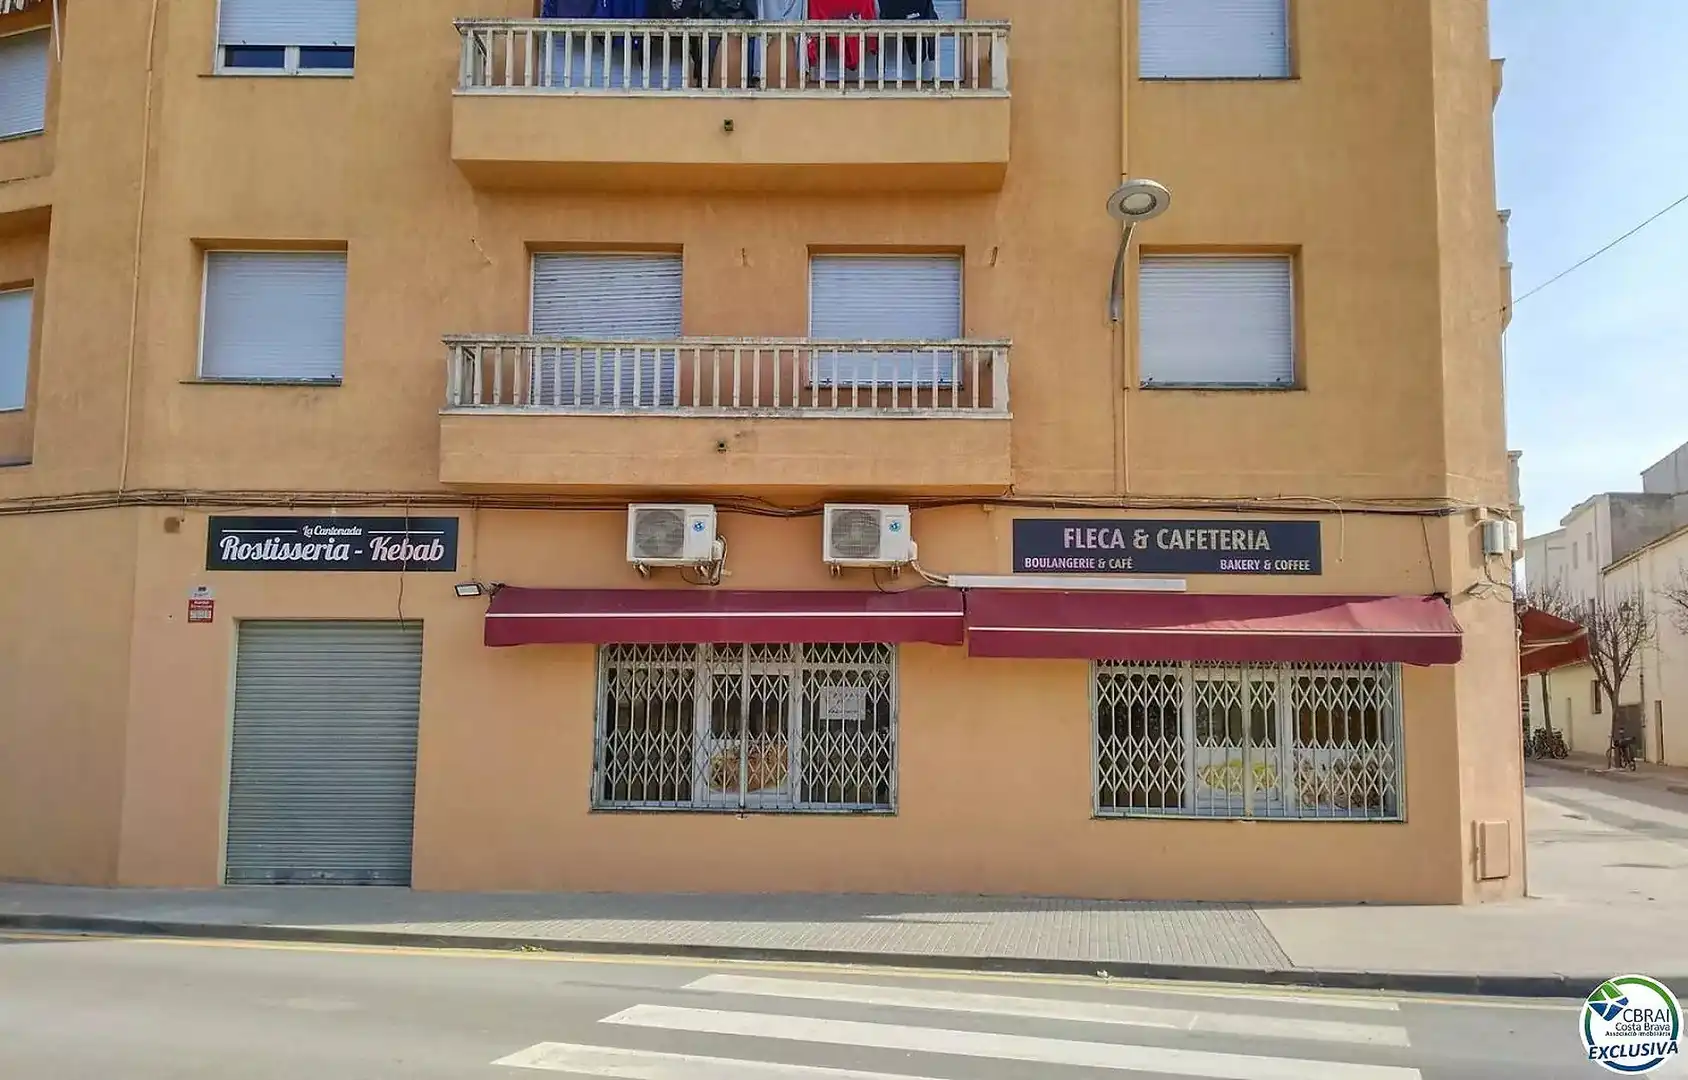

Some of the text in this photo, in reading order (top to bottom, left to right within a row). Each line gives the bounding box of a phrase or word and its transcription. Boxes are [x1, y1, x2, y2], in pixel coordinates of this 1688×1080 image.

[303, 525, 362, 538] La Cantonada
[1063, 527, 1271, 551] FLECA & CAFETERIA
[219, 535, 350, 561] Rostisseria
[369, 536, 445, 561] Kebab
[1024, 556, 1133, 569] BOULANGERIE & CAFÉ
[1220, 559, 1311, 571] BAKERY & COFFEE
